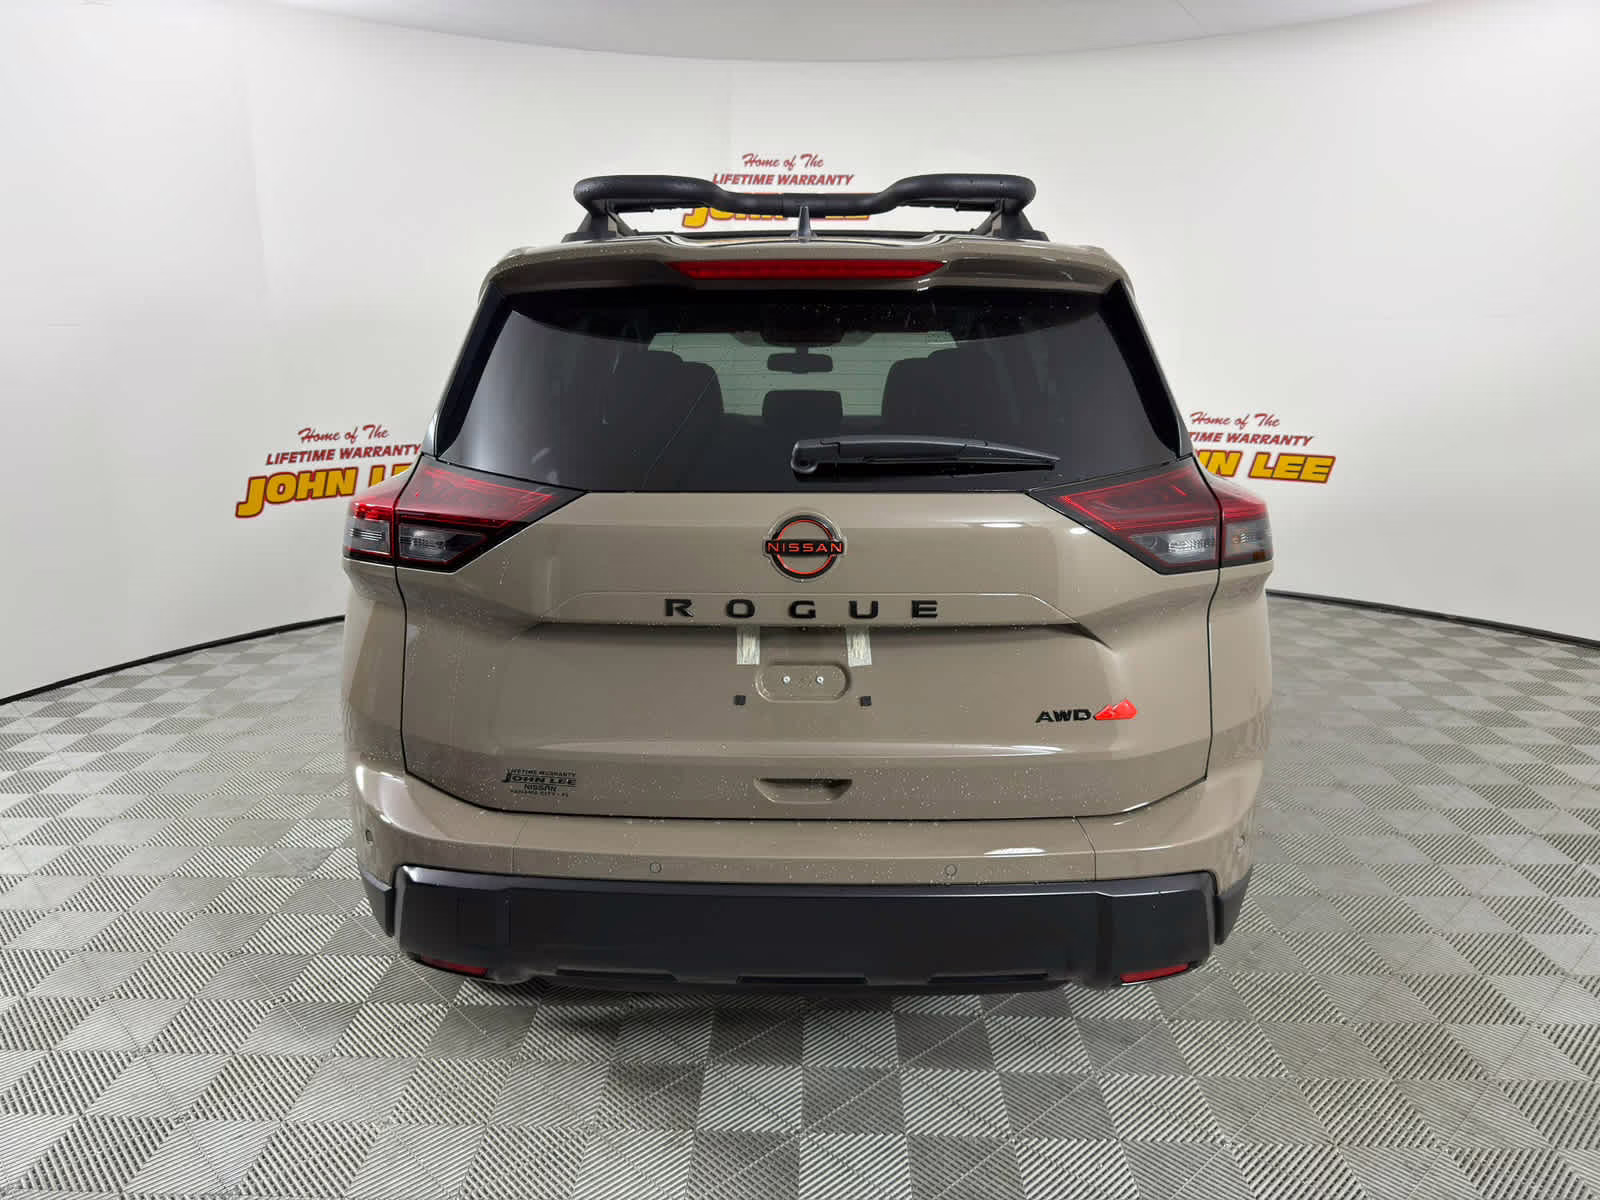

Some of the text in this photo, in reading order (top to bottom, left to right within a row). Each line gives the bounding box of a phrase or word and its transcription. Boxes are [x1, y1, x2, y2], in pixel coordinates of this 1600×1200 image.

[742, 153, 825, 171] Home of The
[712, 173, 854, 186] LIFETIME WARRANTY
[1190, 411, 1280, 430] Home of The
[298, 424, 391, 444] Home of The
[1189, 432, 1314, 447] TIME WARRANTY
[266, 443, 422, 466] LIFETIME WARRANTY
[1249, 452, 1336, 484] LEE
[235, 467, 359, 519] JOHN
[767, 542, 843, 553] NISSAN
[664, 598, 939, 619] ROGUE
[1035, 708, 1092, 724] AWD
[501, 770, 577, 785] JOHN LEE
[524, 783, 557, 792] NISSAN
